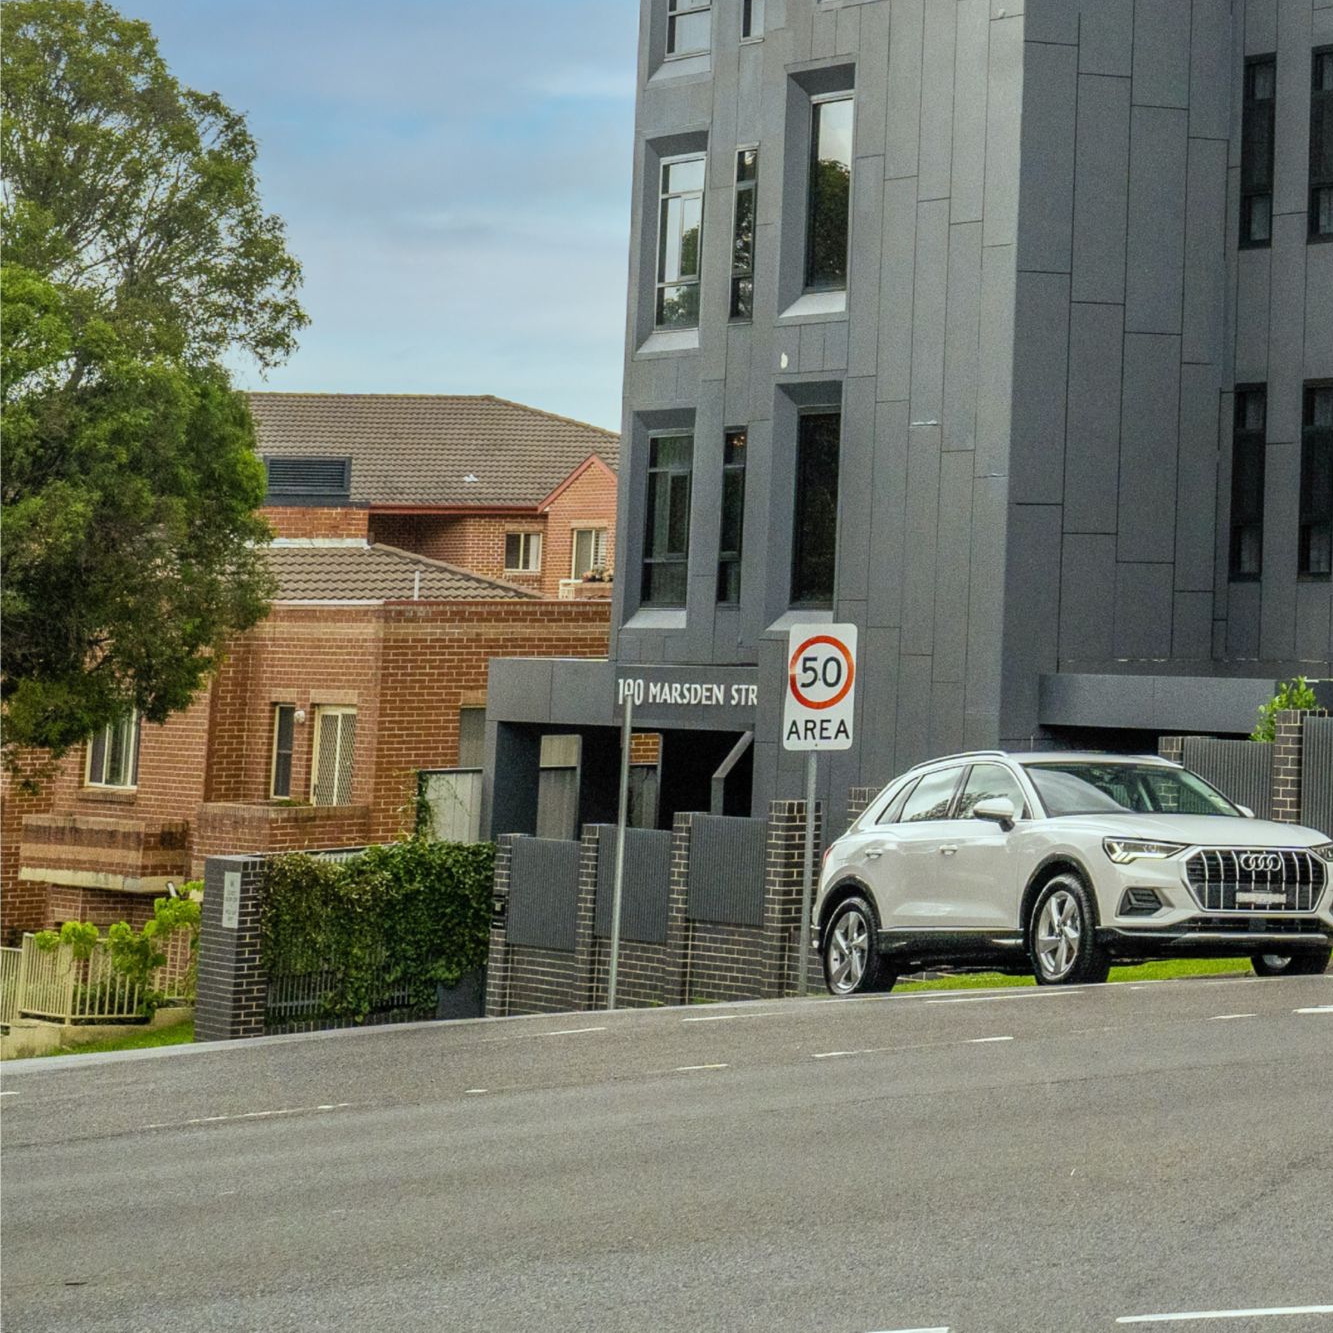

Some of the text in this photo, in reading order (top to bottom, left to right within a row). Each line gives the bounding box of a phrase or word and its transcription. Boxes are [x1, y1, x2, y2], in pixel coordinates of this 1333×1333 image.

[799, 656, 842, 688] 50
[648, 682, 725, 705] MARSDEN
[730, 684, 758, 706] STR
[786, 718, 851, 742] AREA
